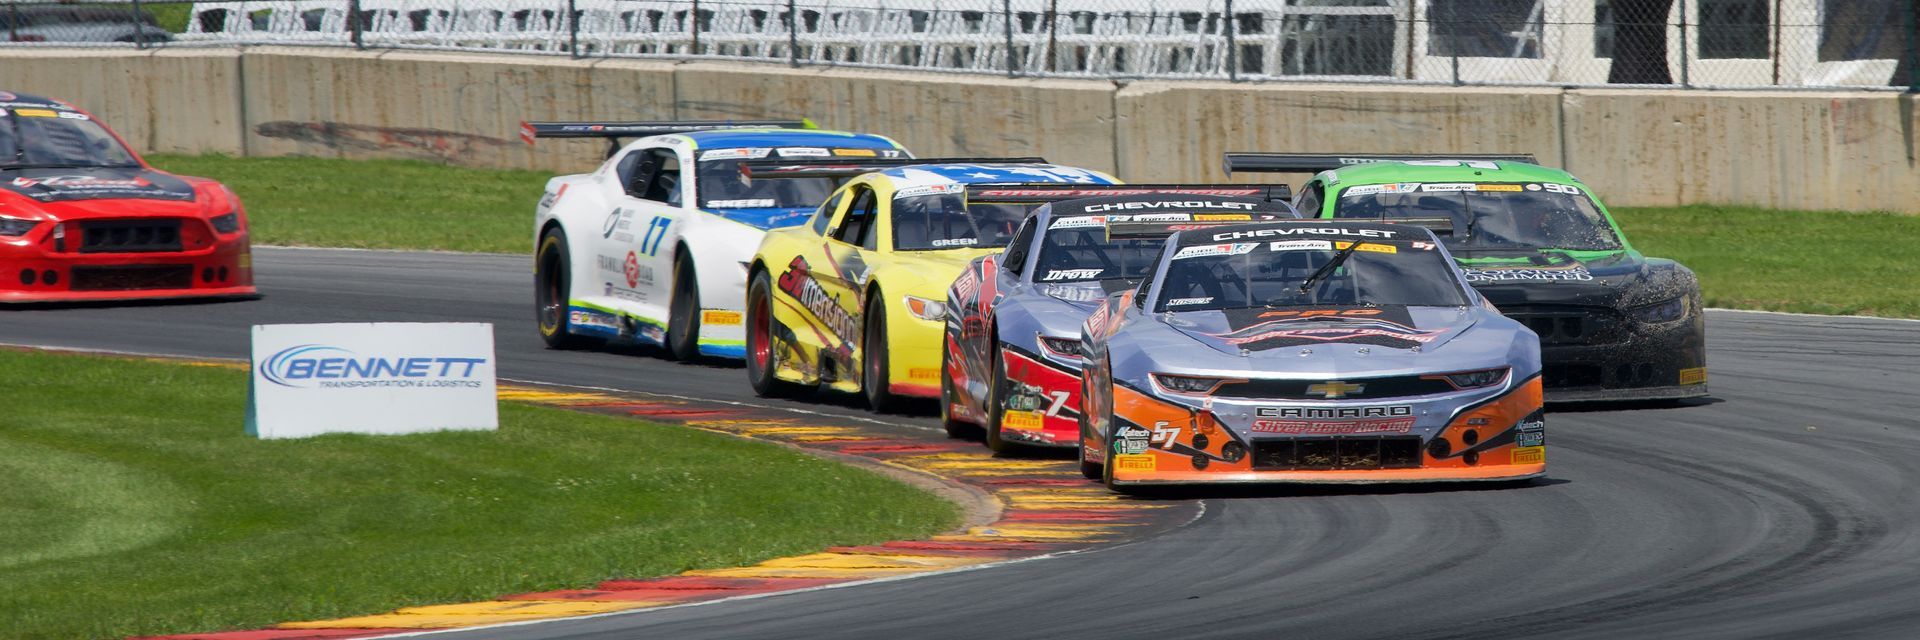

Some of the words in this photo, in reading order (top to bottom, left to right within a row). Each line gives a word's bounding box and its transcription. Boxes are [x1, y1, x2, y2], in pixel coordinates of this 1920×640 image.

[1543, 184, 1580, 195] 90
[705, 199, 775, 209] SKEEN
[1084, 200, 1257, 213] CHEVROLET
[641, 216, 672, 257] 17
[1213, 227, 1396, 242] CHEVROLET
[931, 237, 978, 247] GREEN
[1412, 241, 1434, 250] 57
[1042, 268, 1104, 281] Drew
[1465, 273, 1594, 282] UNLIMITED
[285, 358, 486, 379] BENNETT
[319, 380, 416, 388] TRANSPORTATION
[426, 380, 481, 388] LOGISTICS
[1046, 391, 1070, 417] 7
[1254, 405, 1413, 418] CAMARO
[1252, 420, 1307, 434] Silver
[1356, 416, 1414, 434] Racing
[1151, 421, 1181, 448] 57
[1119, 456, 1154, 470] PIRELLI
